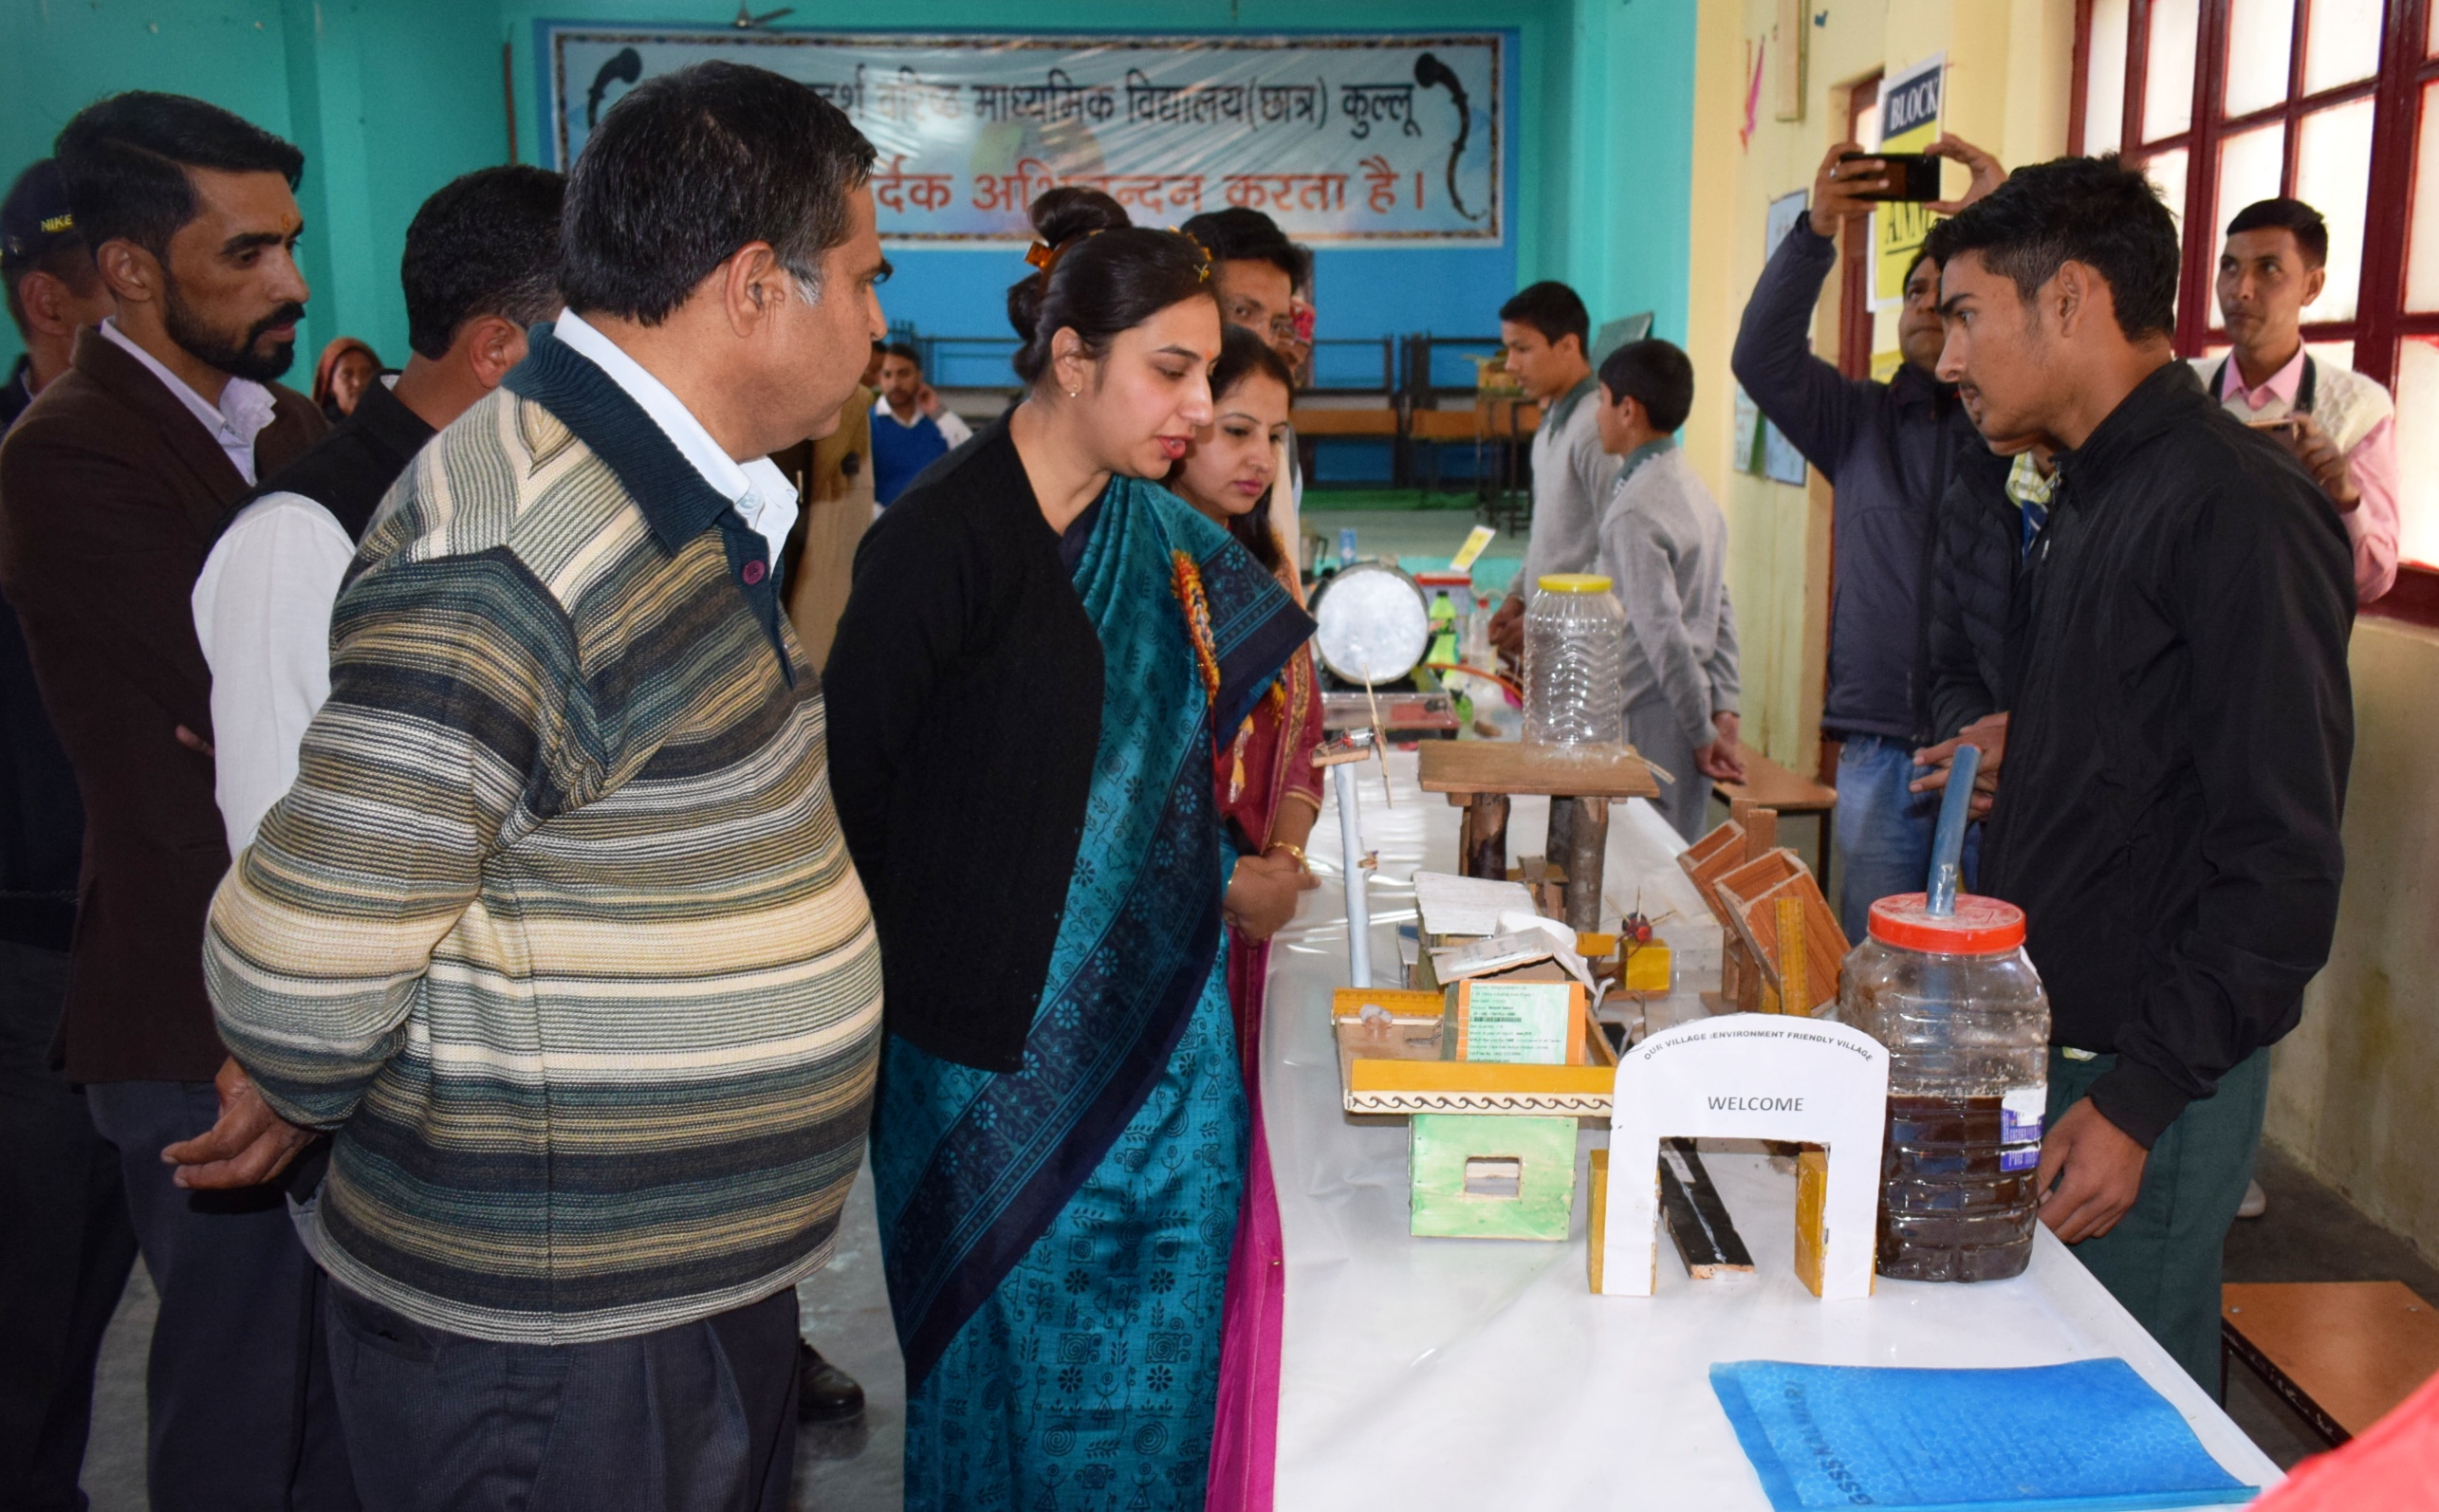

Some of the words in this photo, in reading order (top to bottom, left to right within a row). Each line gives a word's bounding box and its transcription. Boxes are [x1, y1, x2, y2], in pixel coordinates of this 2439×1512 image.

[970, 67, 1116, 124] माध्यमिक
[1340, 83, 1423, 139] कुल्लू
[1889, 77, 1939, 131] BLOCK
[1224, 173, 1349, 212] करता
[40, 213, 73, 233] NIKE
[1644, 1043, 1664, 1060] OUR
[1665, 1033, 1707, 1047] VILLAGE
[1787, 1031, 1835, 1044] FRIENDLY
[1837, 1039, 1873, 1061] VILLAGE
[1708, 1096, 1804, 1112] WELCOME
